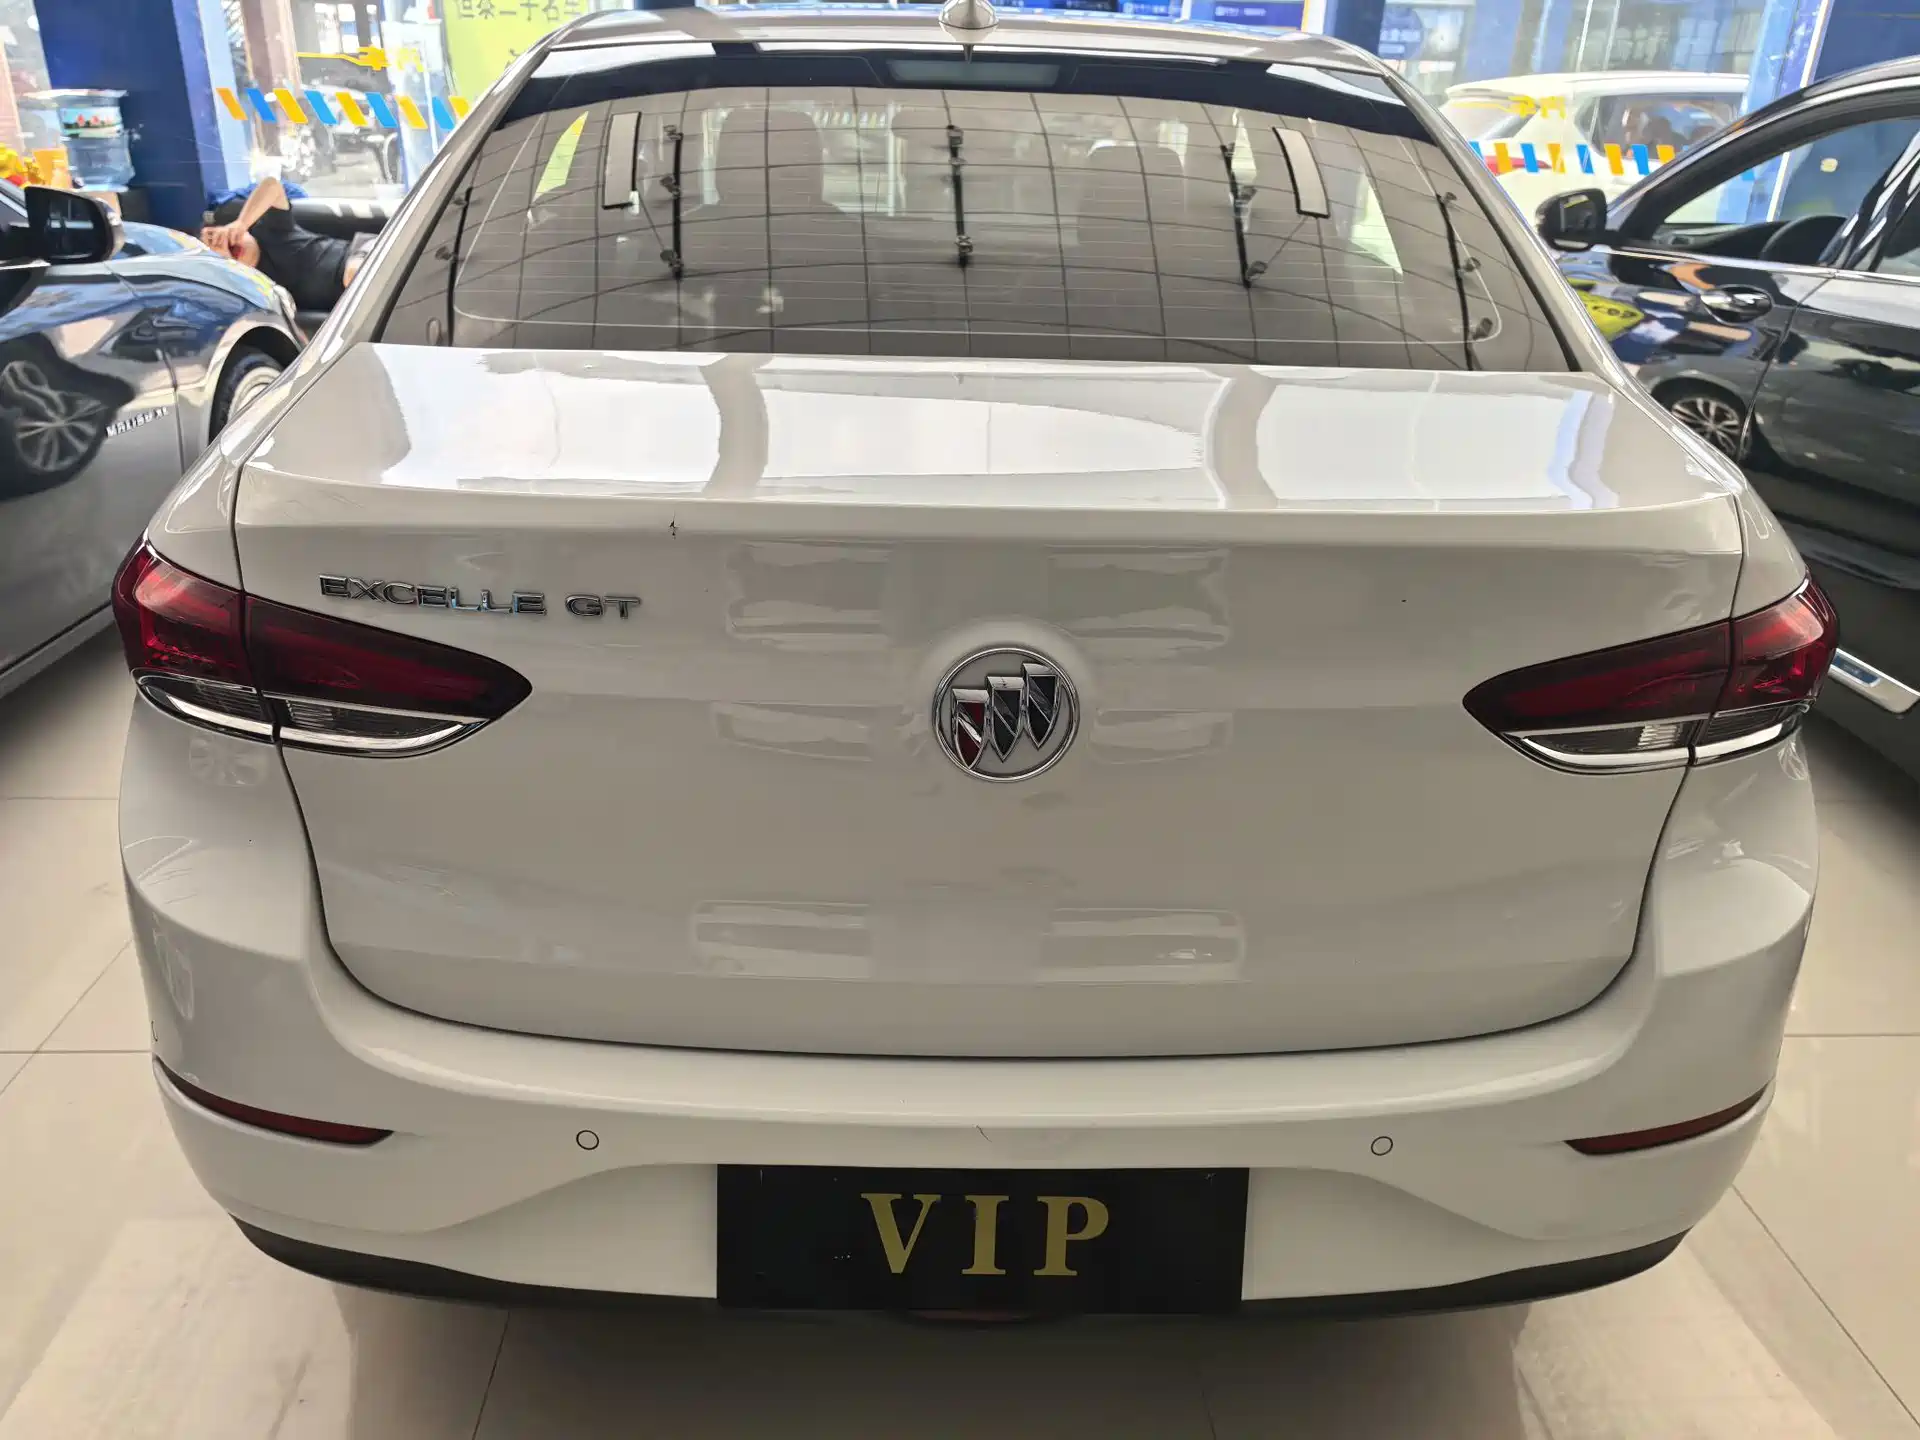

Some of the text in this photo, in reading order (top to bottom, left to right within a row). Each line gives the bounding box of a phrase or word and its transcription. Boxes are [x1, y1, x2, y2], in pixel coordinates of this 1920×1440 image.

[319, 573, 641, 619] EXCELLE GT
[860, 1192, 1109, 1276] VIP
